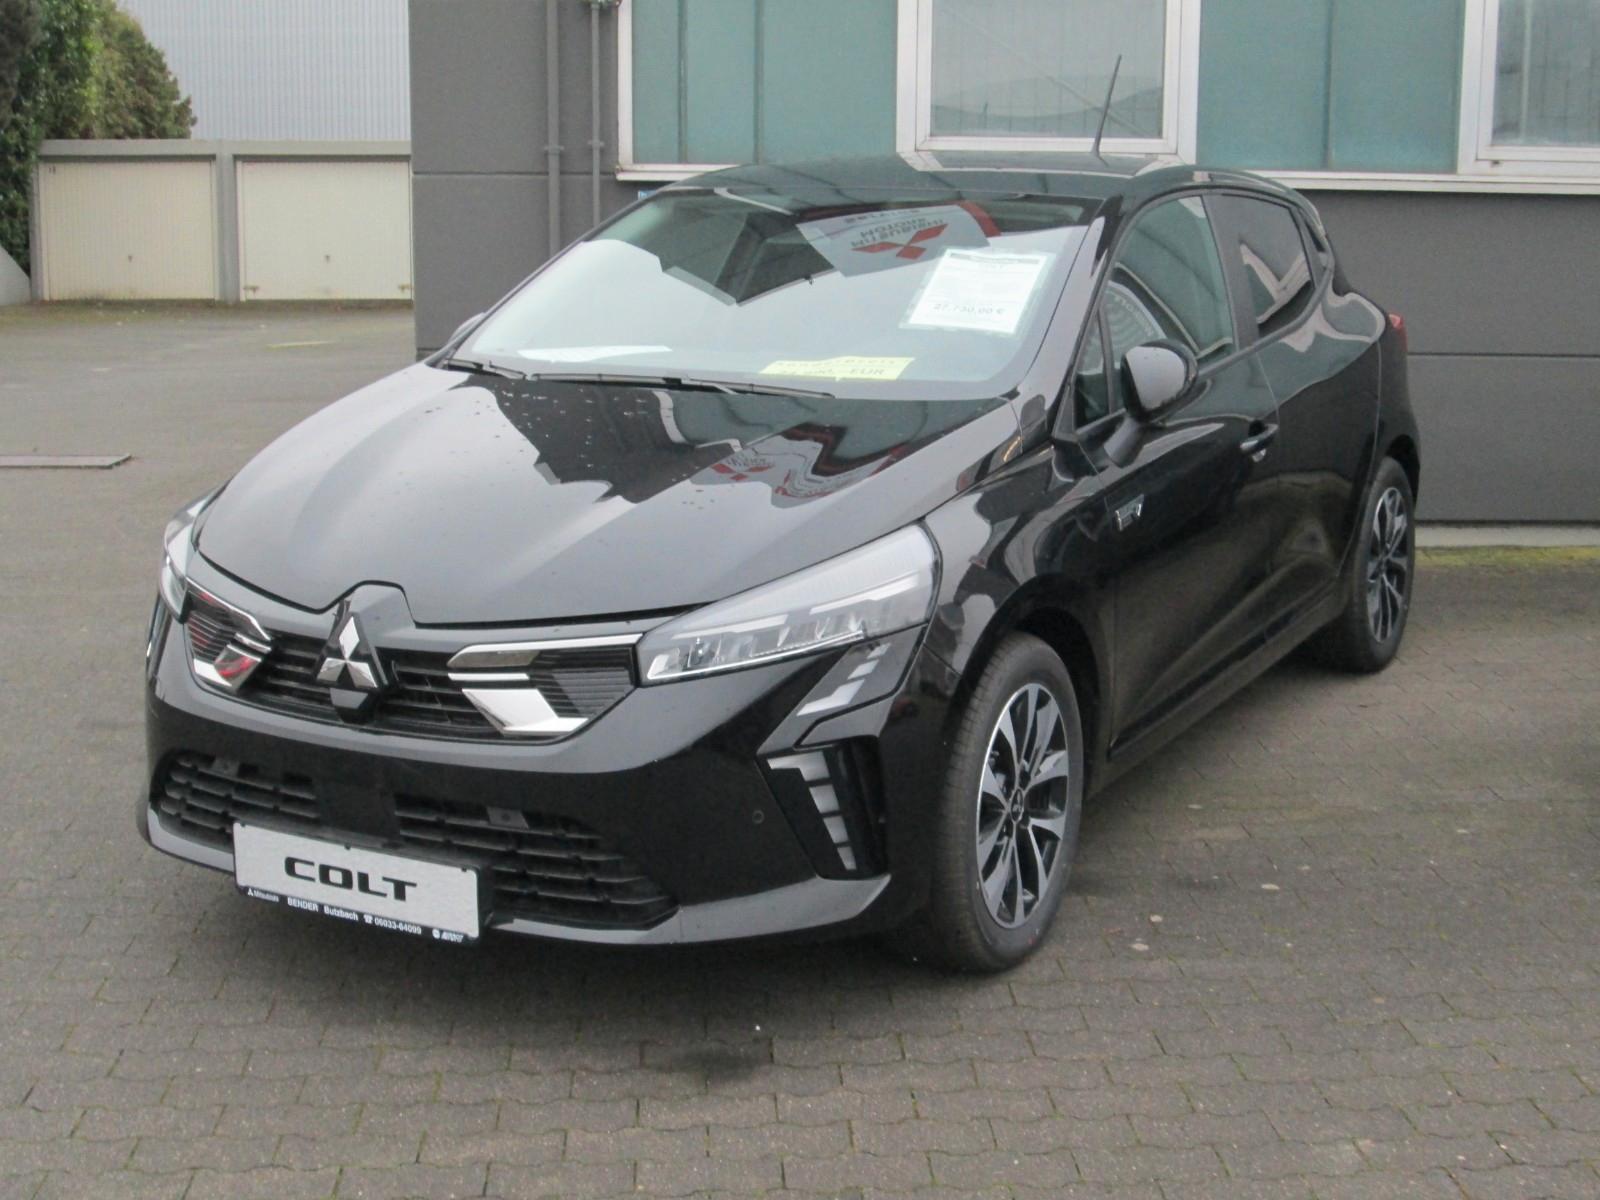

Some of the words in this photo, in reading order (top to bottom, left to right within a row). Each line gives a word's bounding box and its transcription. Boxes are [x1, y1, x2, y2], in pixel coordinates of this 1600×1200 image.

[284, 856, 417, 902] COLT
[287, 896, 319, 912] BENDER
[323, 904, 359, 921] Butzbach
